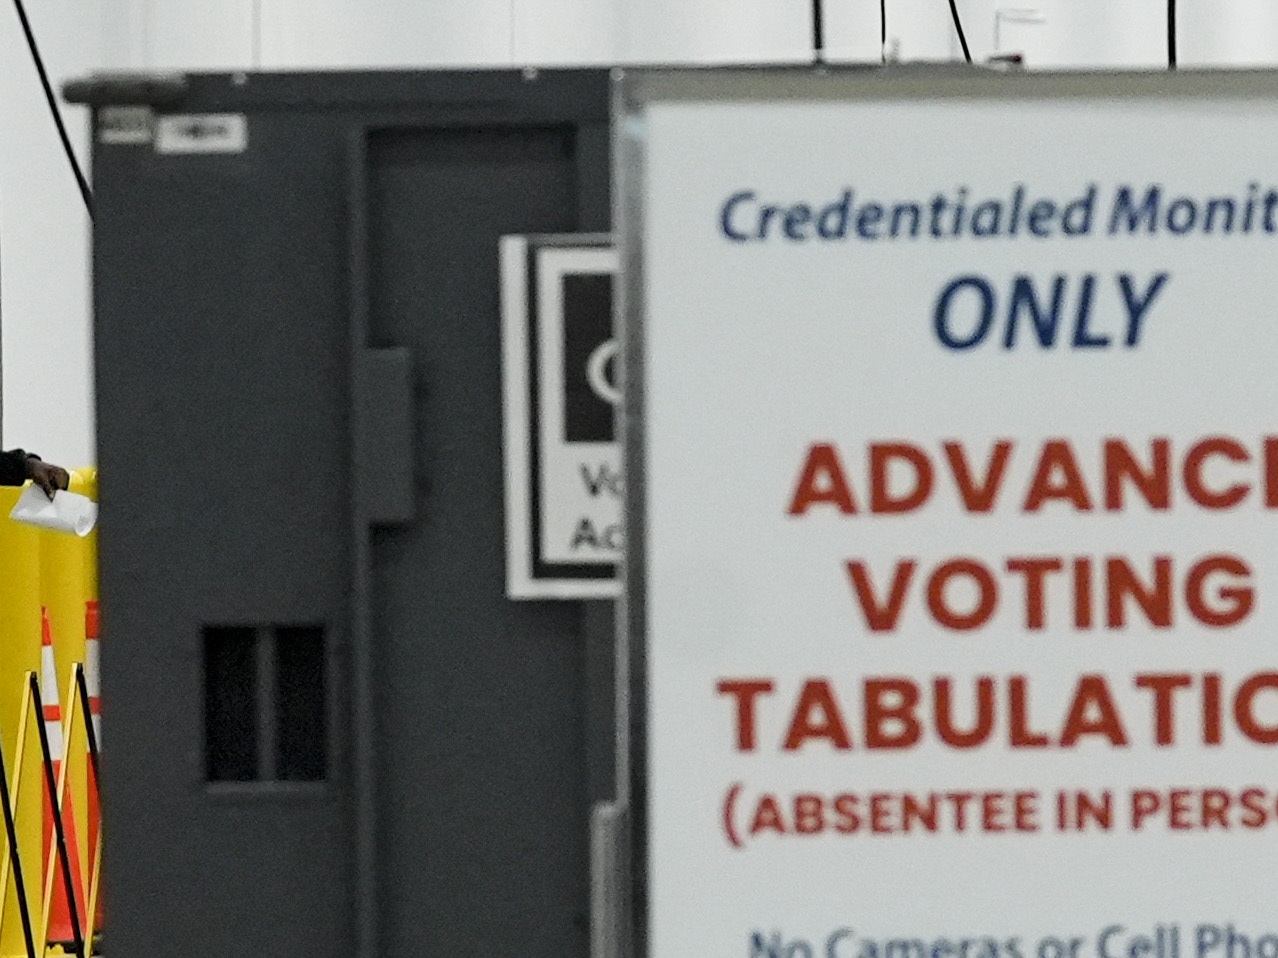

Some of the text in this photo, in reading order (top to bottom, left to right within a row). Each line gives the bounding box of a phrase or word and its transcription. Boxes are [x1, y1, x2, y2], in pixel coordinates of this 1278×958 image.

[719, 184, 1097, 243] Credentialed
[932, 273, 1168, 352] ONLY
[846, 554, 1255, 633] VOTING
[722, 785, 1038, 848] (ABSENTEE
[1056, 791, 1113, 831] IN
